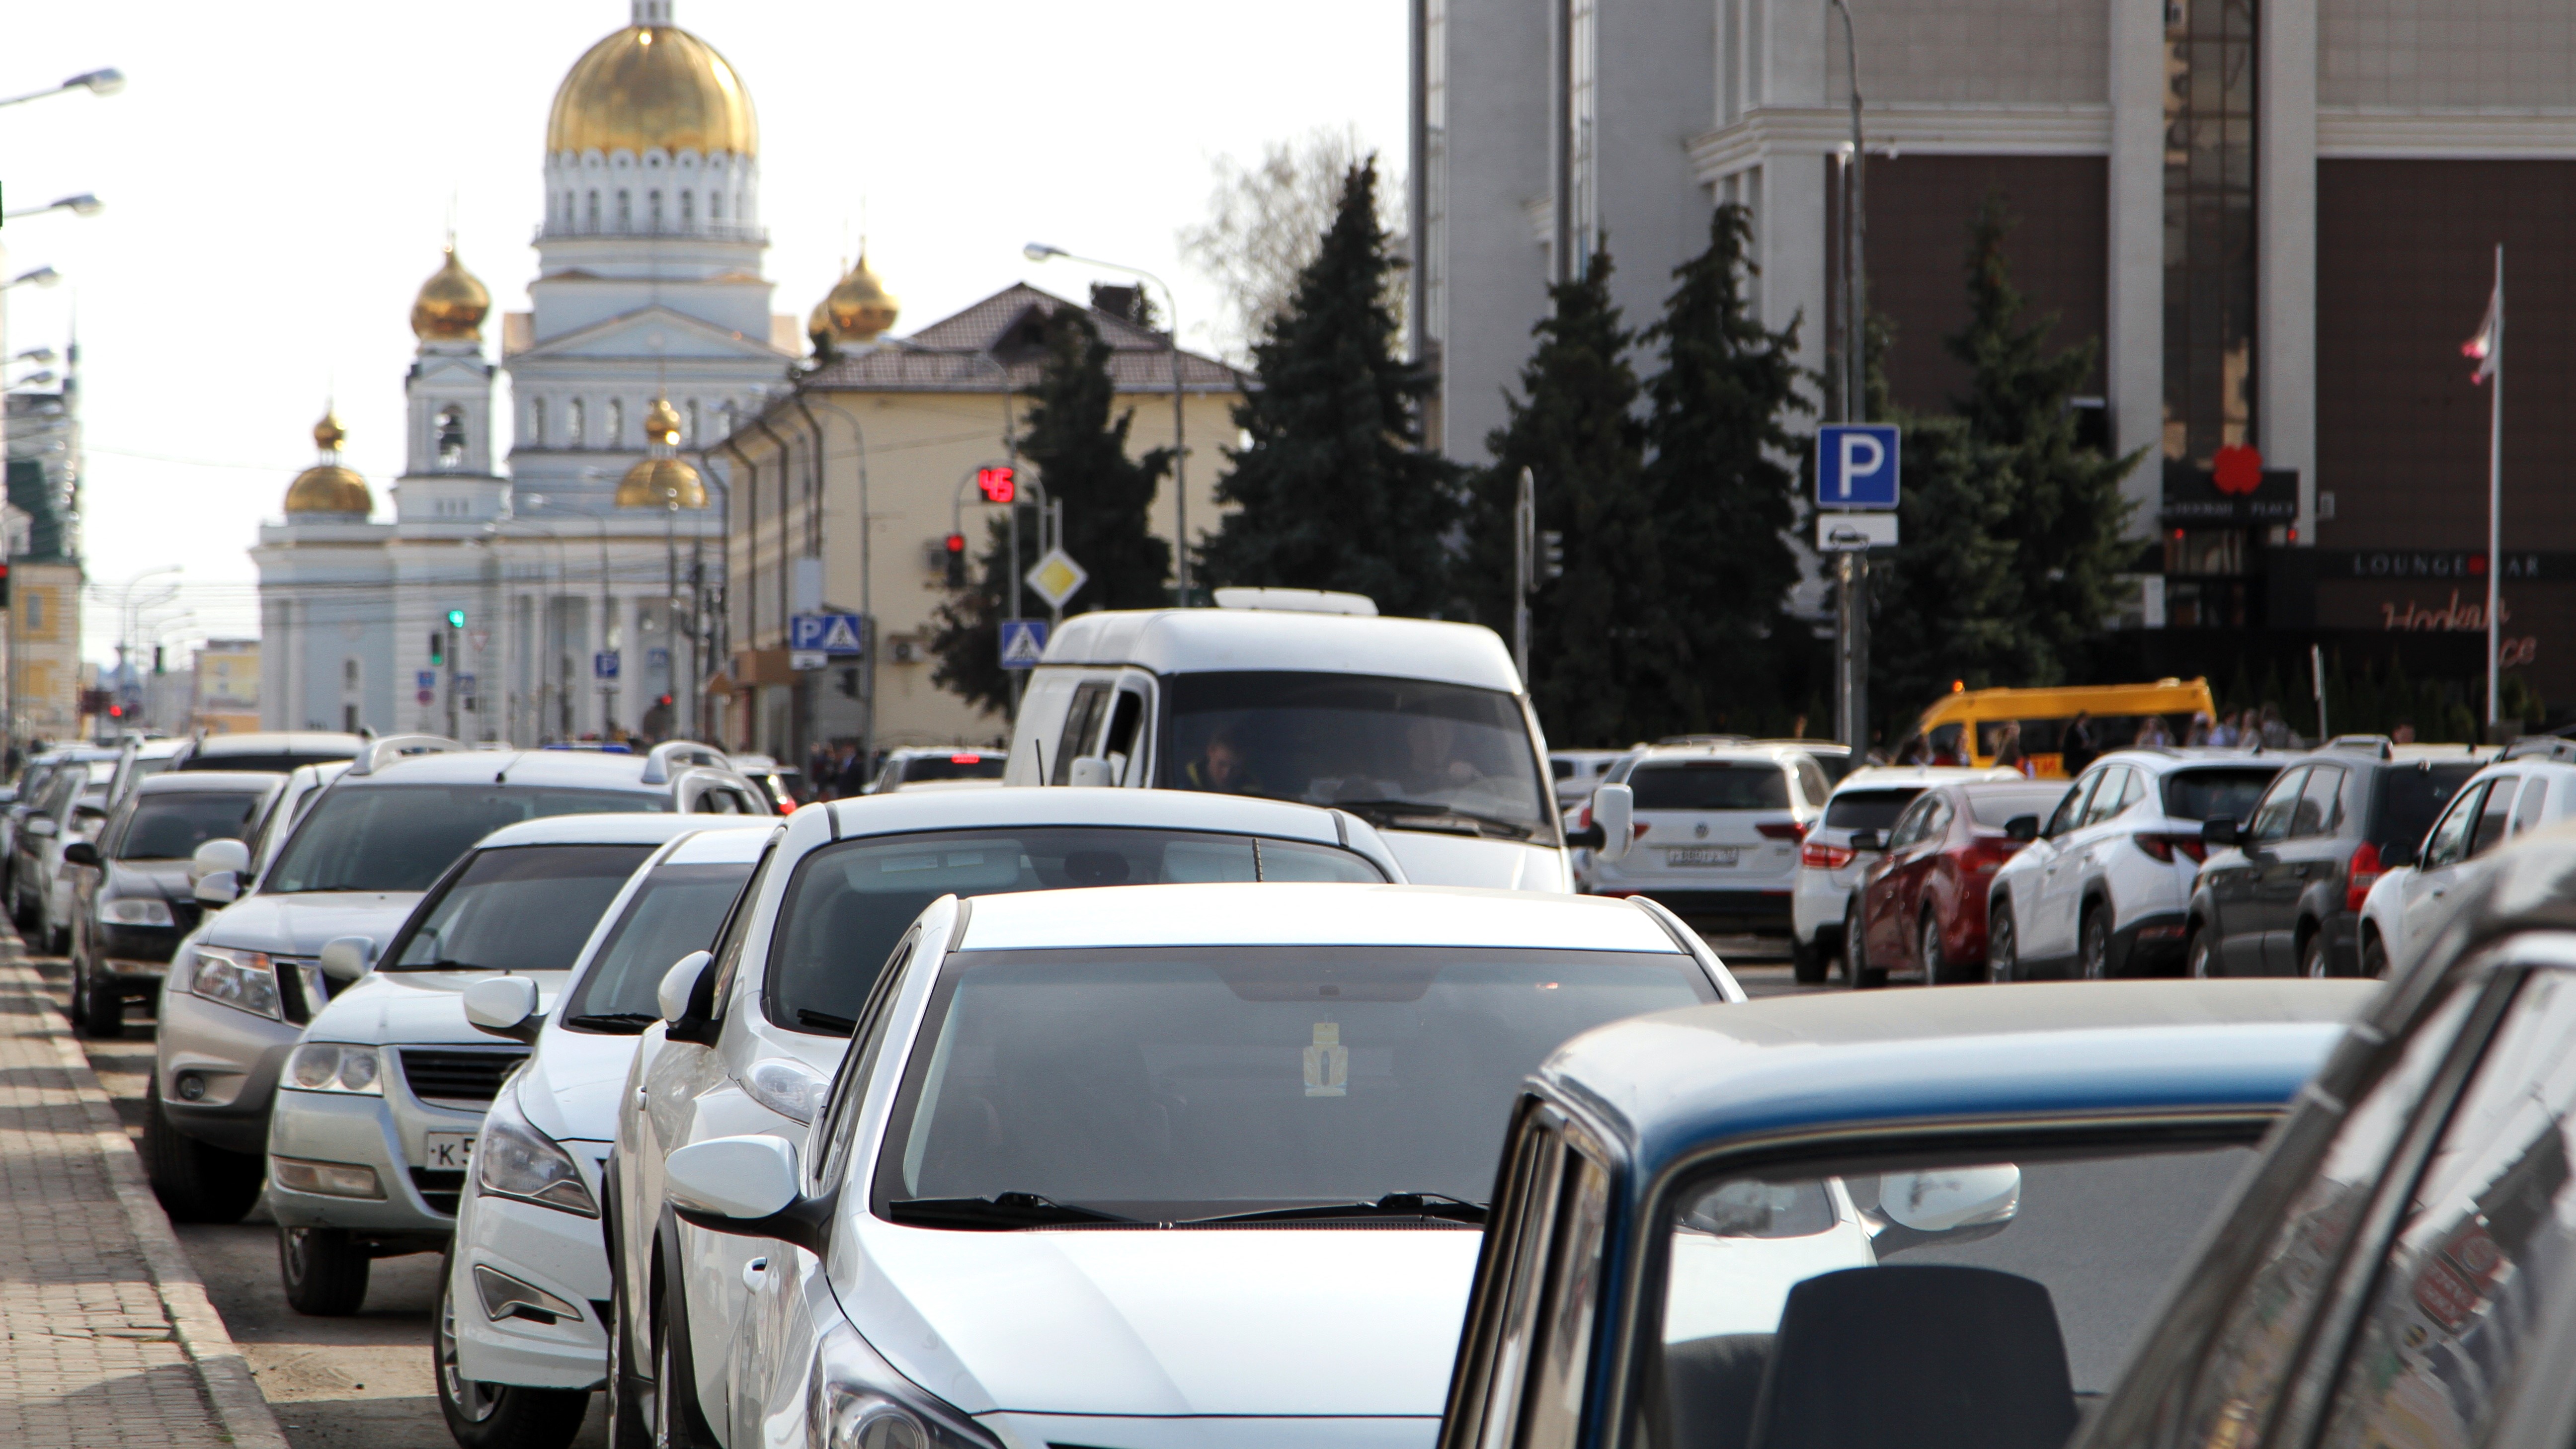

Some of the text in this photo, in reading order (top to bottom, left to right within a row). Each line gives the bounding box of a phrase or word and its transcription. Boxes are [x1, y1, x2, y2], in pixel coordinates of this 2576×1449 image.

[1840, 433, 1885, 498] P
[2353, 555, 2539, 577] LOUNGE AR
[798, 621, 821, 648] P
